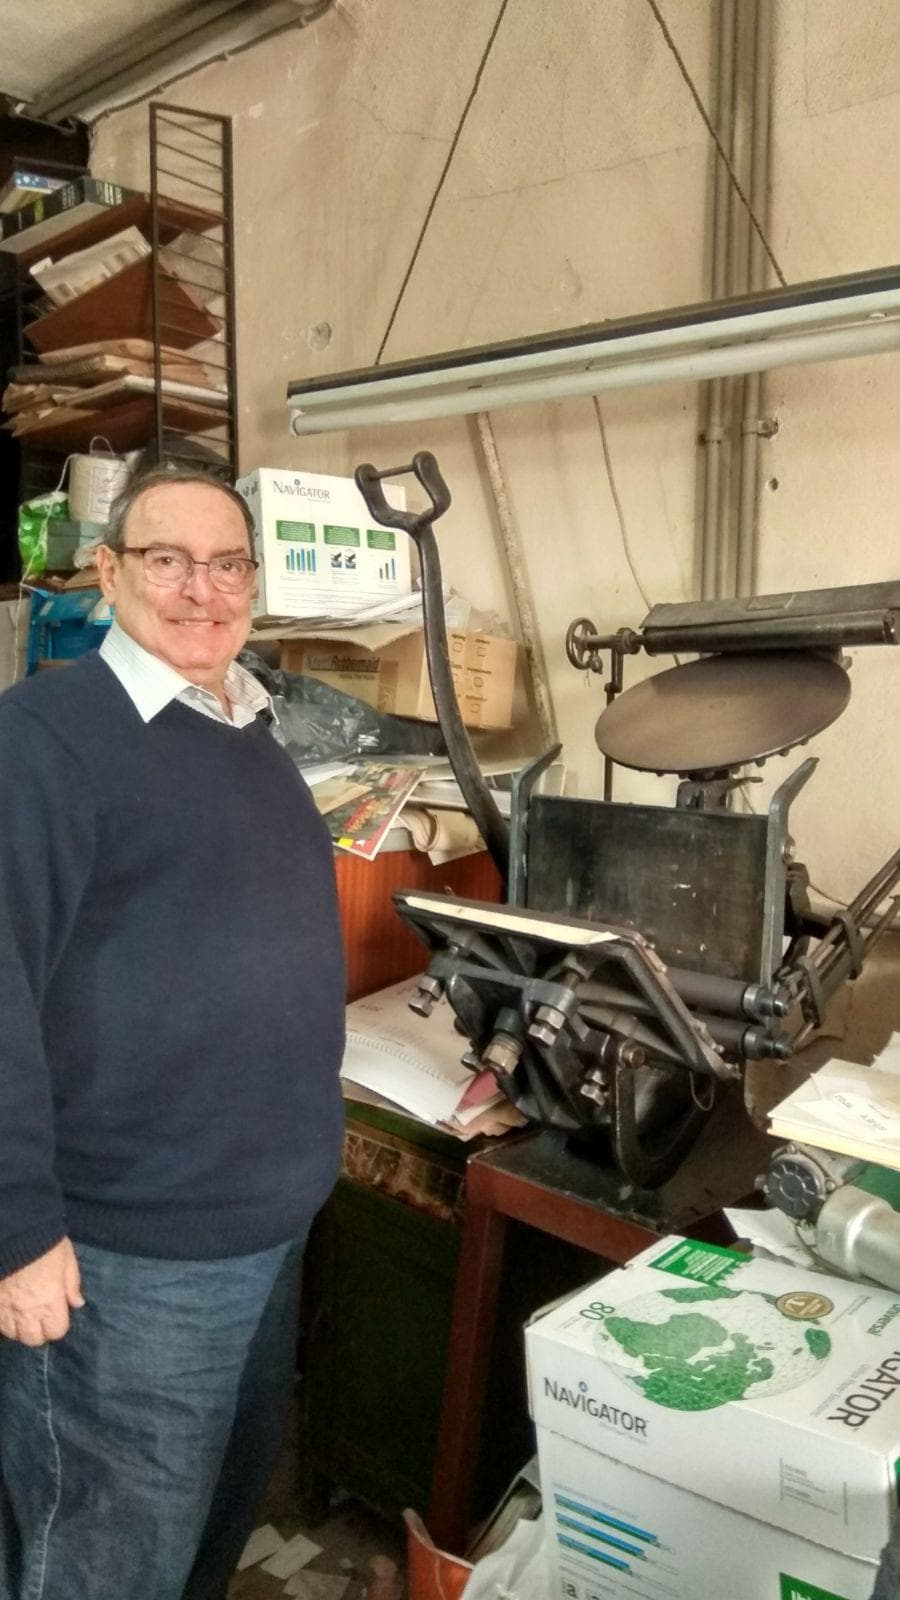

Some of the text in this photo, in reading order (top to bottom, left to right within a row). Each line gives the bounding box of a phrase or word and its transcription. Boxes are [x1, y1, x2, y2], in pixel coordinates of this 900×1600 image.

[273, 480, 330, 500] NAVIGATOR
[580, 1302, 615, 1320] 80
[544, 1377, 647, 1437] NAVIGATOR
